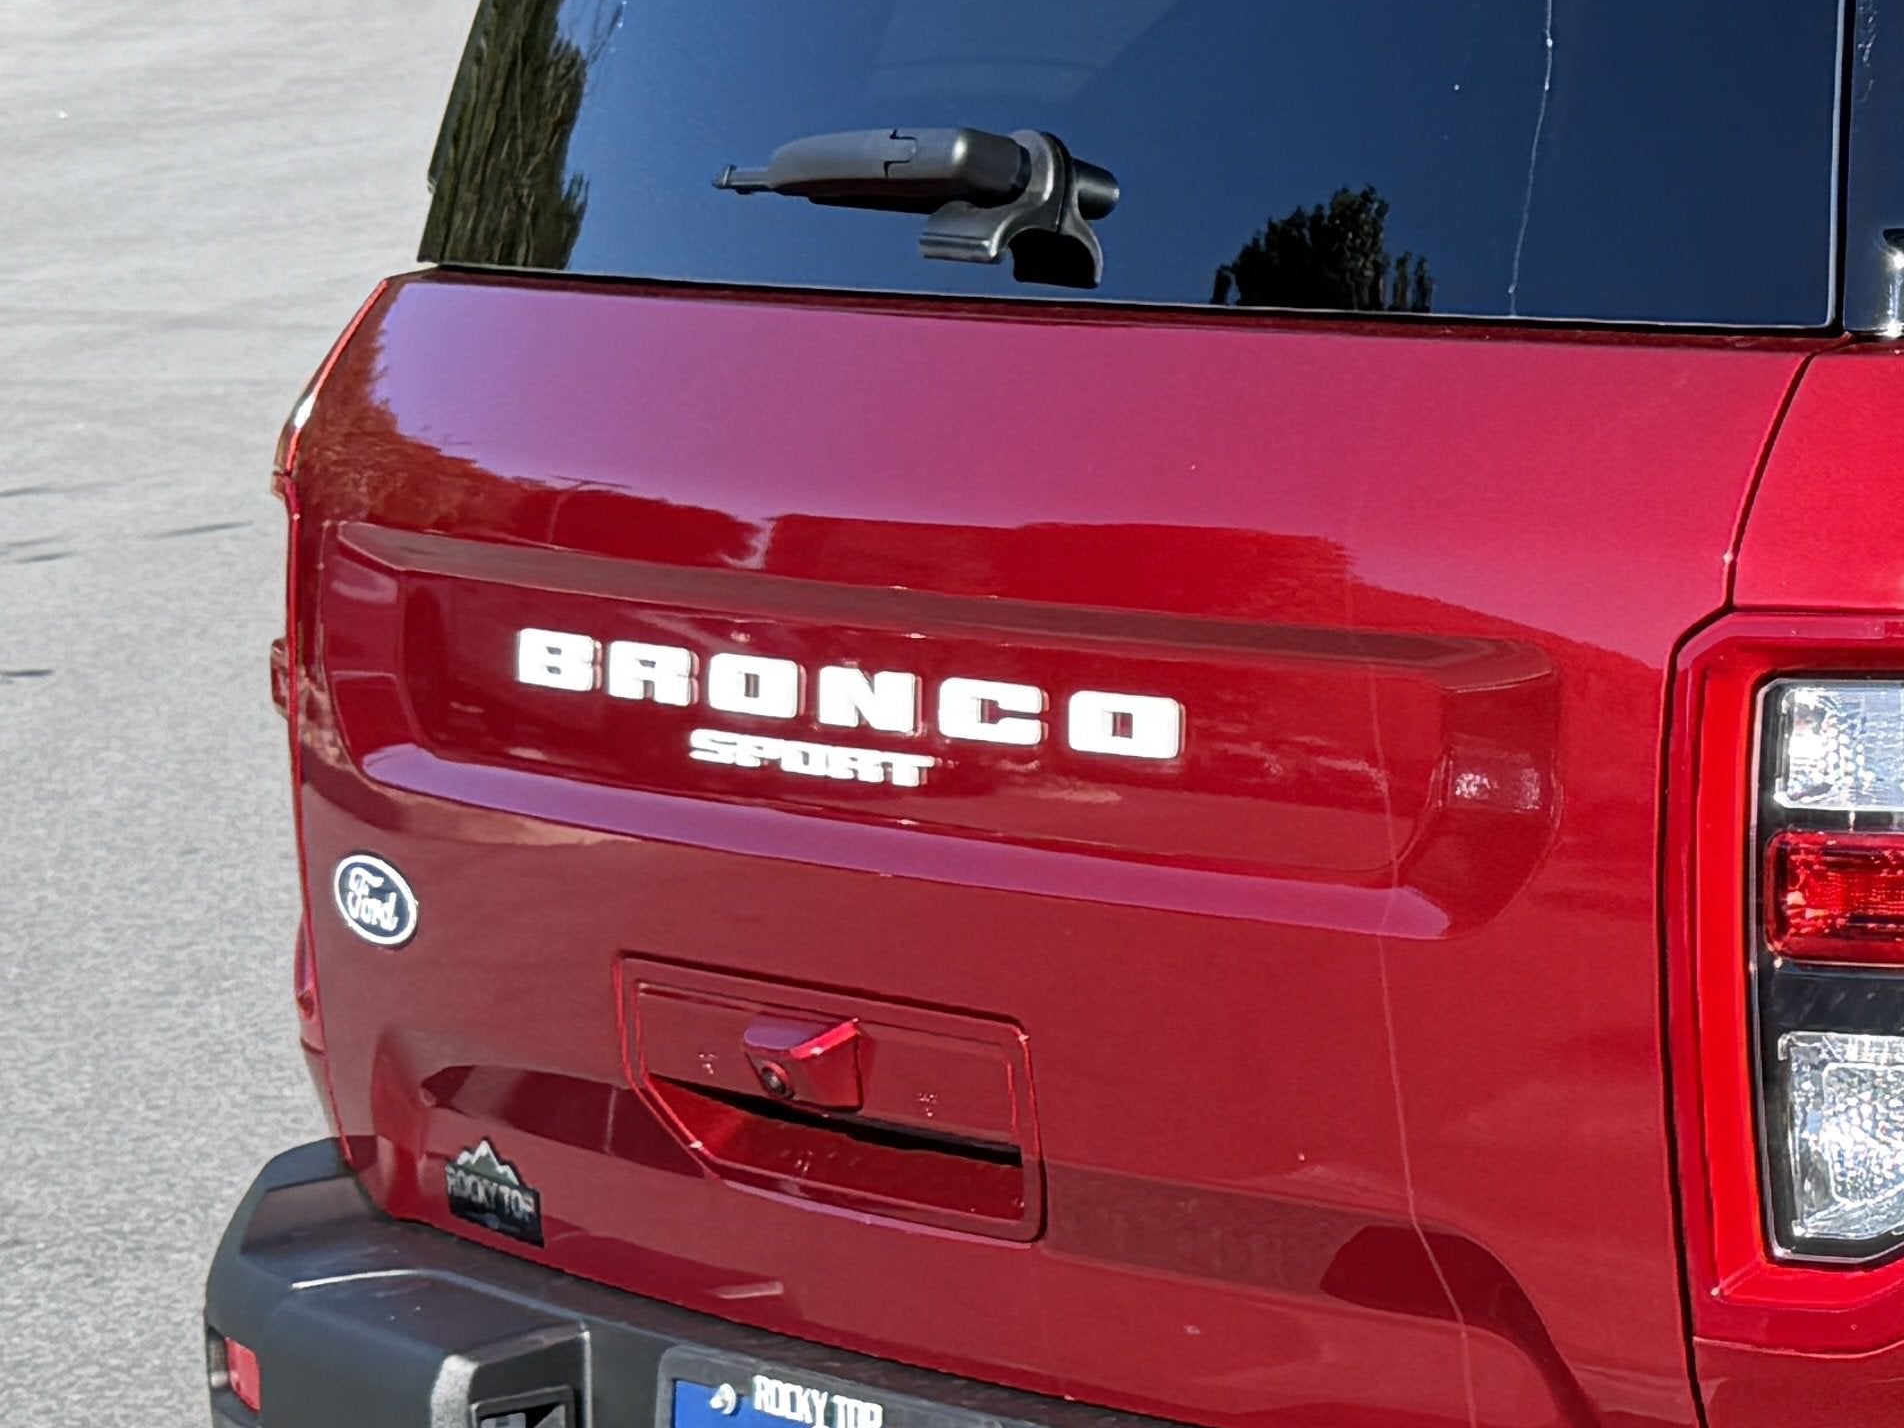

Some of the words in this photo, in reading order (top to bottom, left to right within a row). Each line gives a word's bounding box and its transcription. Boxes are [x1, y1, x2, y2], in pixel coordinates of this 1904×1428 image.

[516, 627, 1186, 761] BRONCO
[689, 727, 936, 788] SPORT
[347, 867, 399, 931] Ford
[752, 1374, 829, 1426] ROCKY
